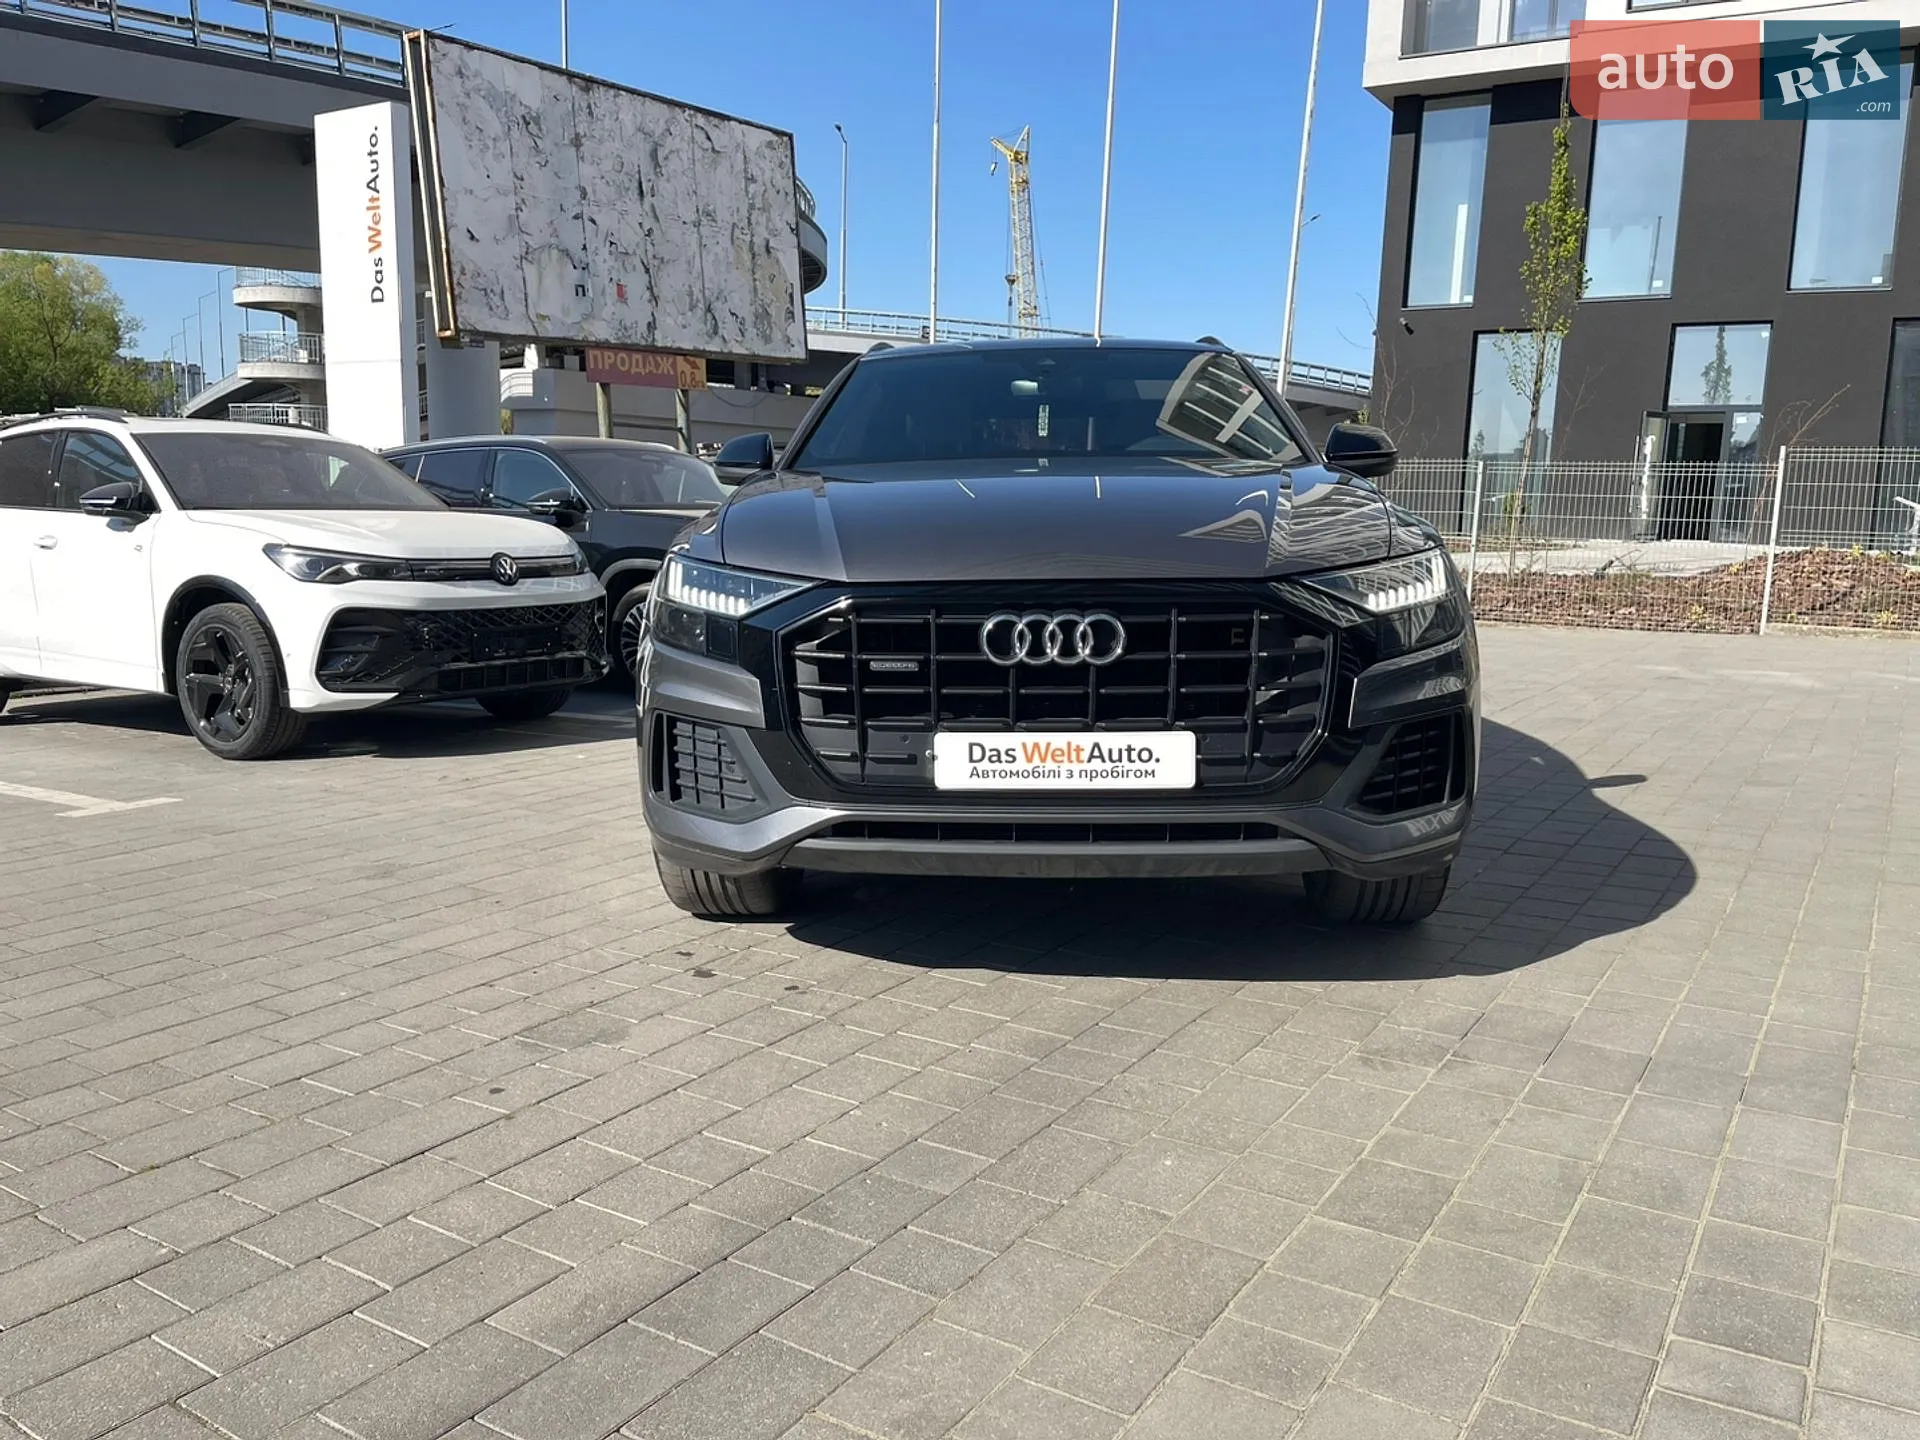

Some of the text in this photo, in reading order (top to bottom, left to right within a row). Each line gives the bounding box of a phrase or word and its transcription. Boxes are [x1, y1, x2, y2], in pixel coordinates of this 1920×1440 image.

[371, 257, 384, 303] Das
[590, 351, 674, 375] ПРОДАЖ
[967, 741, 1017, 764] Das
[969, 765, 1156, 782] Автомобілі з пробігом
